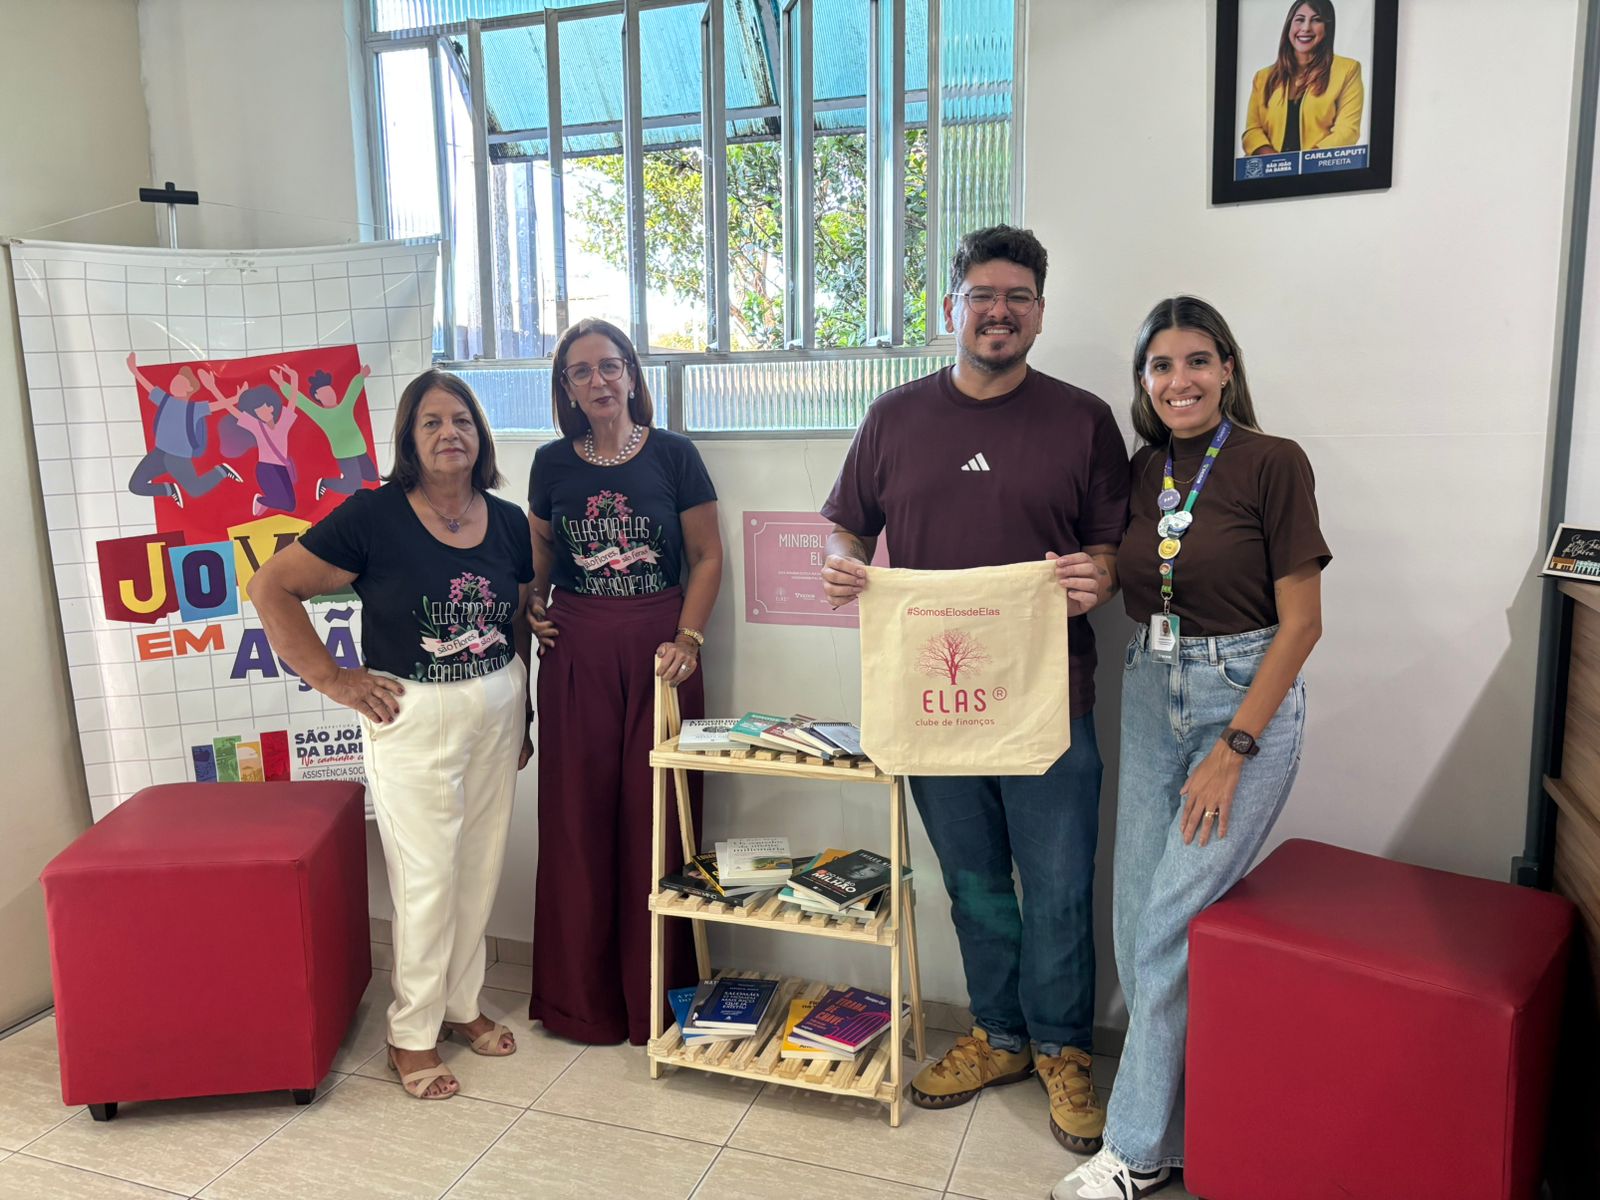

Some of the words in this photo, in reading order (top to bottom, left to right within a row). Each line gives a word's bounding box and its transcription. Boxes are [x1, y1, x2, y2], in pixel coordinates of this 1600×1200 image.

[1304, 152, 1333, 161] CARLA
[1334, 148, 1366, 157] CAPUTI
[1318, 158, 1351, 167] PREFEITA
[569, 519, 598, 542] ELAS
[907, 607, 1000, 617] #SomosElosdeElas
[136, 624, 226, 661] EM
[923, 688, 987, 713] ELAS
[915, 718, 938, 726] clube
[942, 718, 953, 726] de
[956, 717, 995, 728] finanças
[294, 729, 330, 745] SÃO
[296, 746, 320, 758] DA
[301, 756, 314, 767] No
[317, 754, 355, 764] caminho
[302, 766, 348, 779] ASSISTÊNCIA
